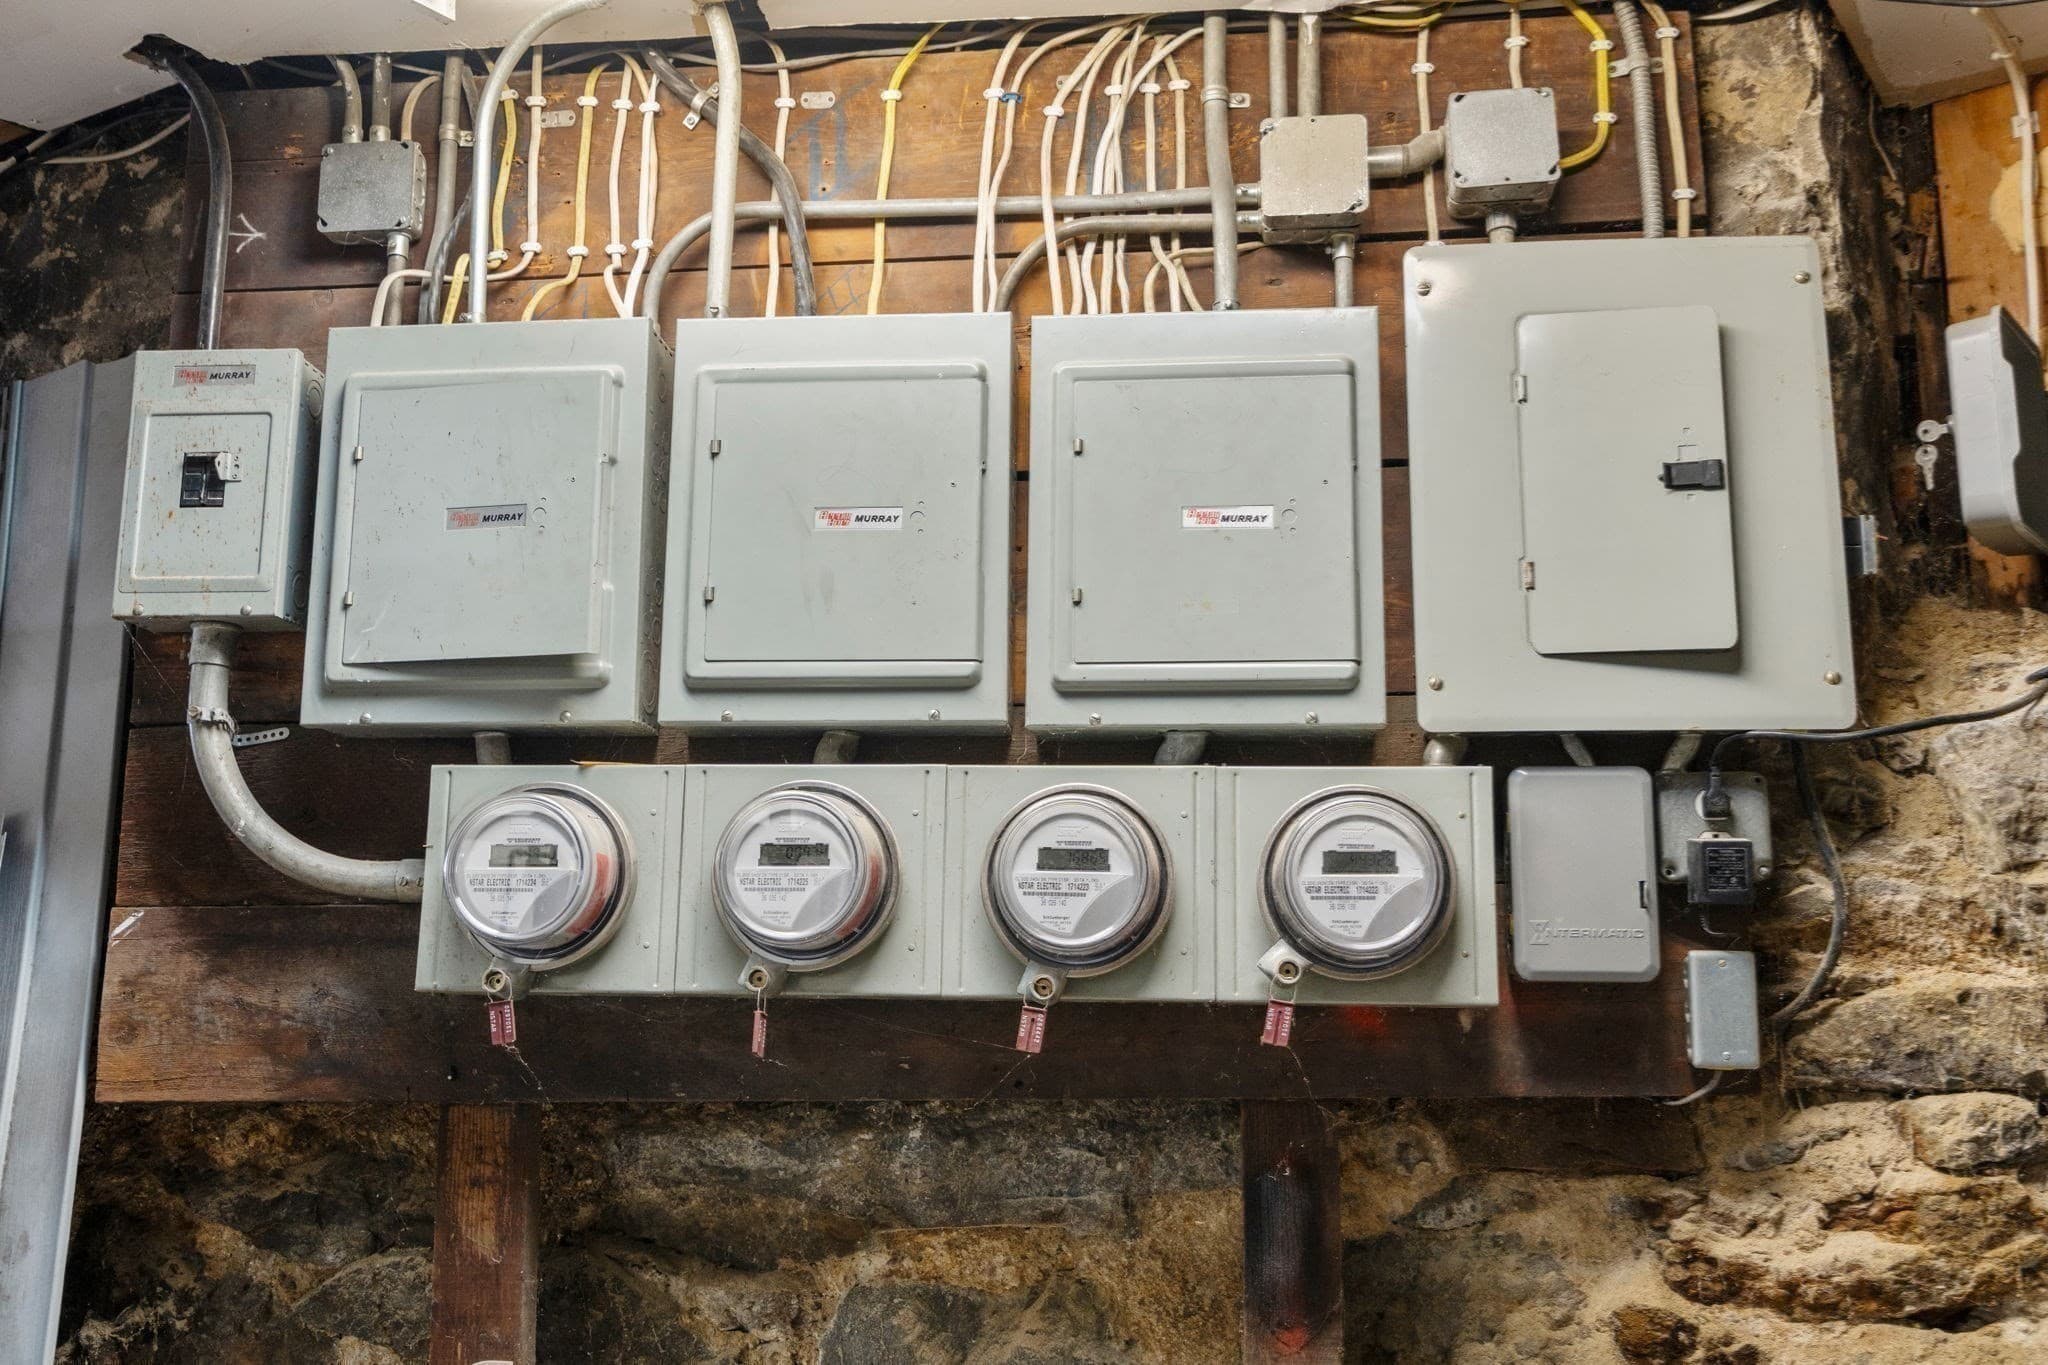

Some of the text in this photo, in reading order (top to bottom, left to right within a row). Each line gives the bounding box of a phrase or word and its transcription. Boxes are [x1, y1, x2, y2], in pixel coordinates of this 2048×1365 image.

[209, 371, 252, 380] MURRAY
[481, 512, 524, 523] MURRAY
[854, 514, 900, 523] MURRAY
[1220, 514, 1267, 523] MURRAY
[469, 878, 484, 886] NSTAR
[486, 878, 511, 886] ELECTRIC
[739, 877, 755, 886] NSTAR
[757, 877, 782, 886] ELECTRIC
[1018, 881, 1035, 890] NSTAR
[1036, 881, 1062, 891] ELECTRIC
[1324, 885, 1350, 894] ELECTRIC
[489, 1010, 497, 1033] NSTAR
[1264, 1007, 1275, 1030] NSTAR
[1019, 1014, 1028, 1037] NSTAR
